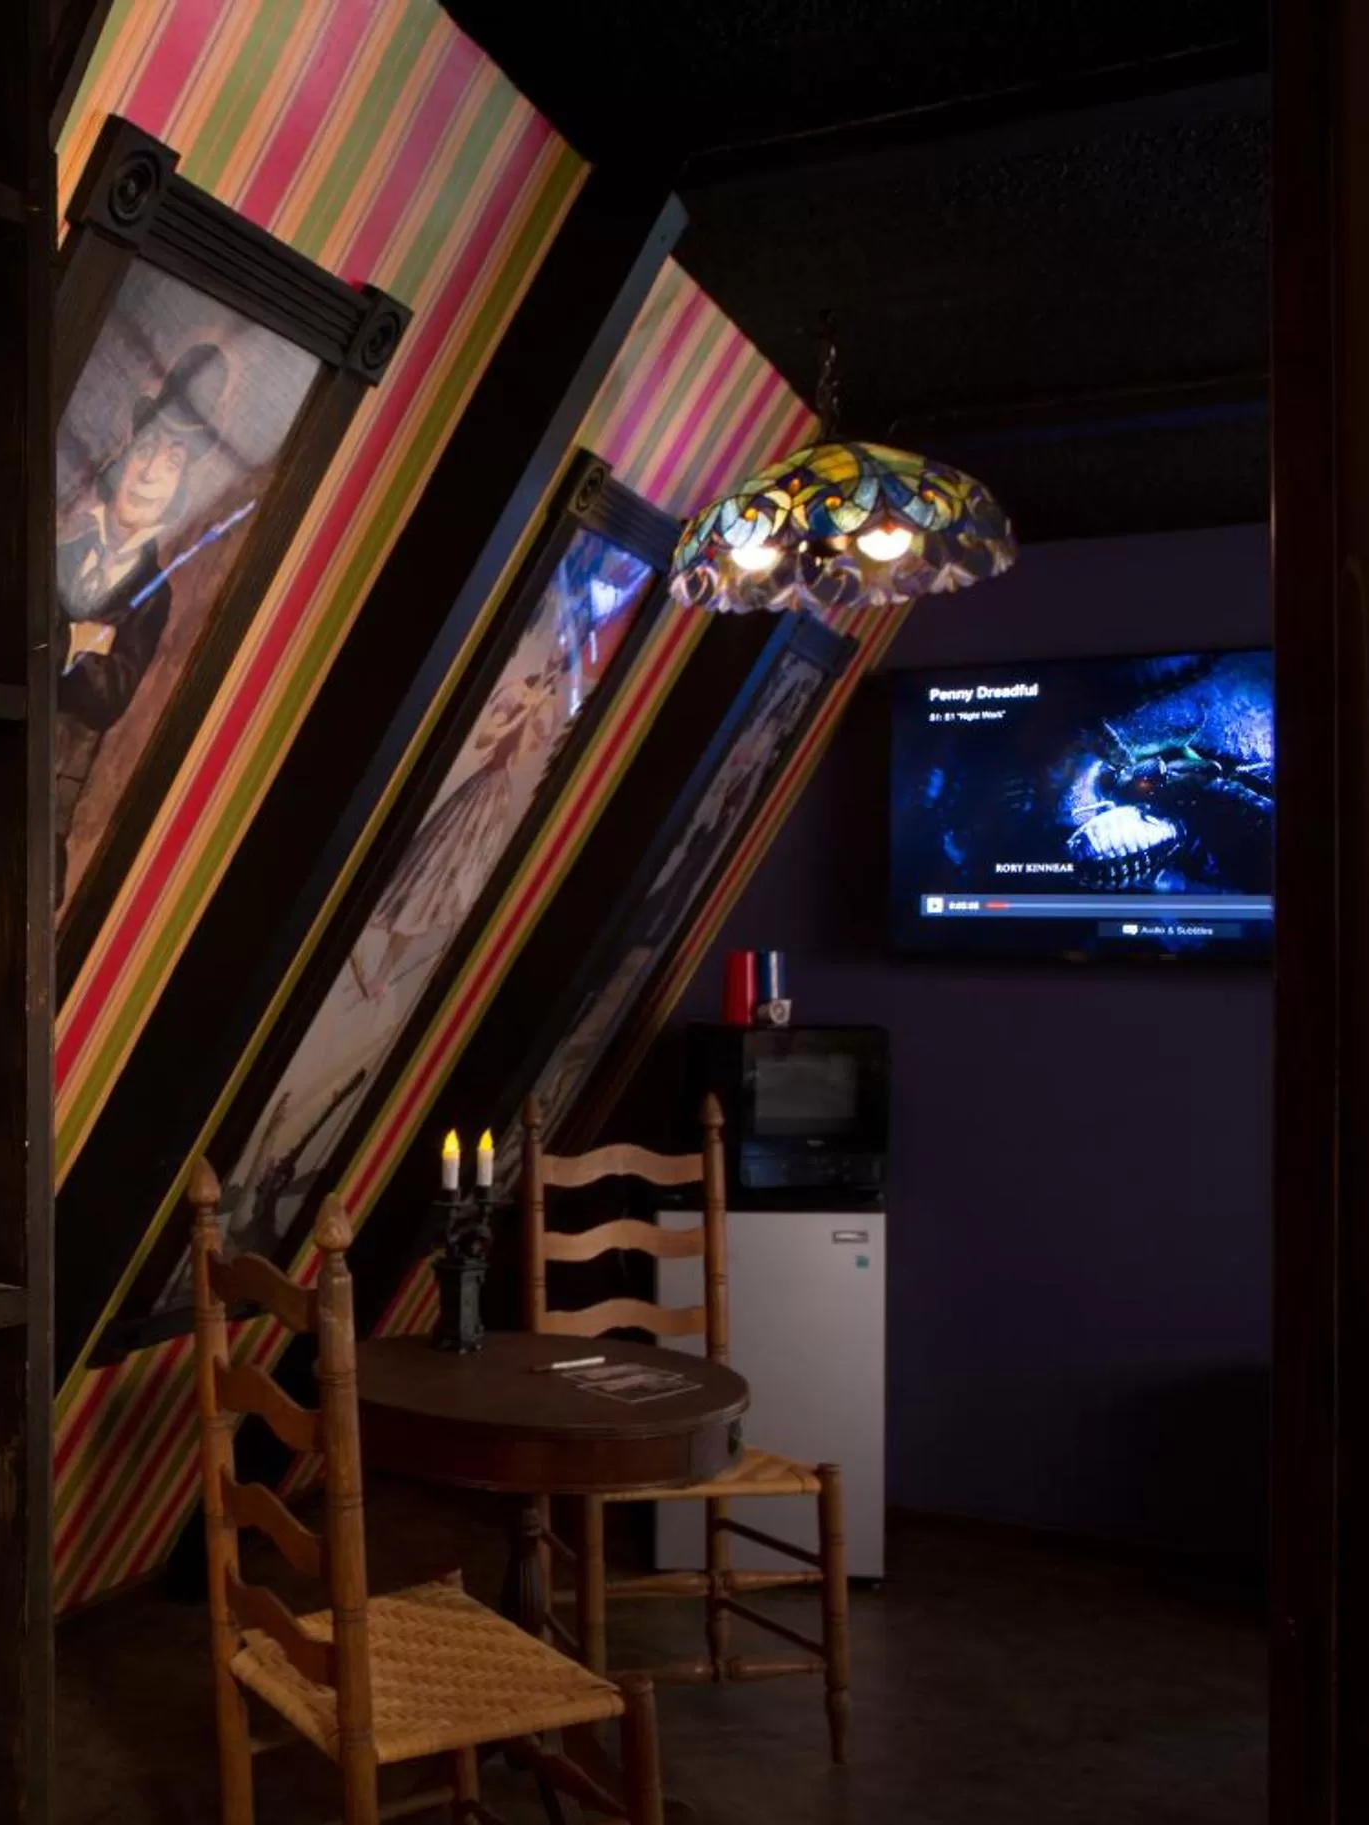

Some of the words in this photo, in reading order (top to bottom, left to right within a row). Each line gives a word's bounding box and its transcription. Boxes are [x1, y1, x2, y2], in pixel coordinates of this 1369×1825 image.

[929, 686, 974, 703] Penny
[976, 682, 1039, 700] Dreadful
[995, 863, 1023, 874] RORY
